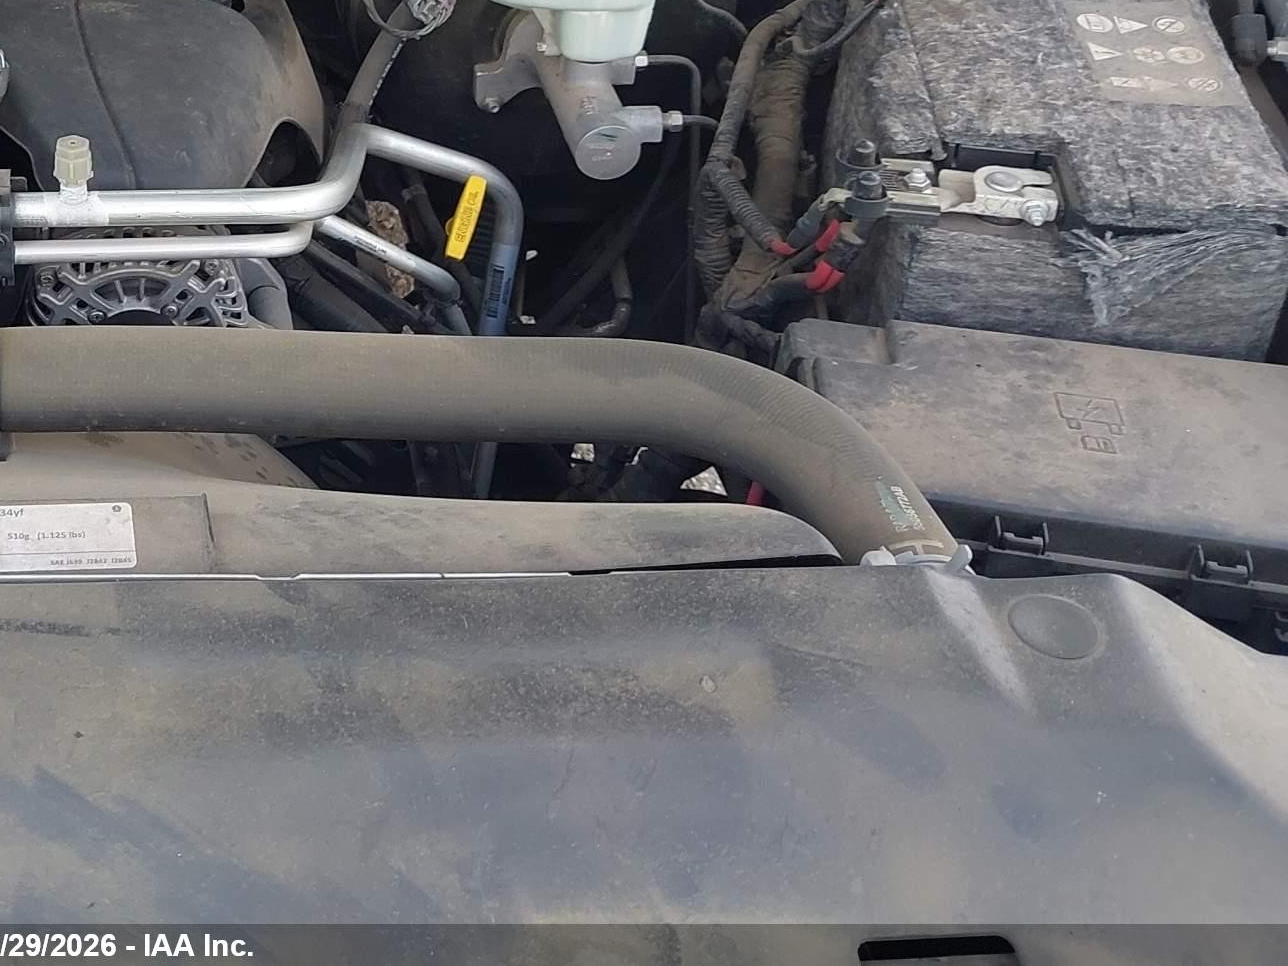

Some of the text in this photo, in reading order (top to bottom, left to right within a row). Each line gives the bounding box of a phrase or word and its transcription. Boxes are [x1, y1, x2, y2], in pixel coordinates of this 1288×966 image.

[7, 530, 86, 541] 510g (1.125 lbs)
